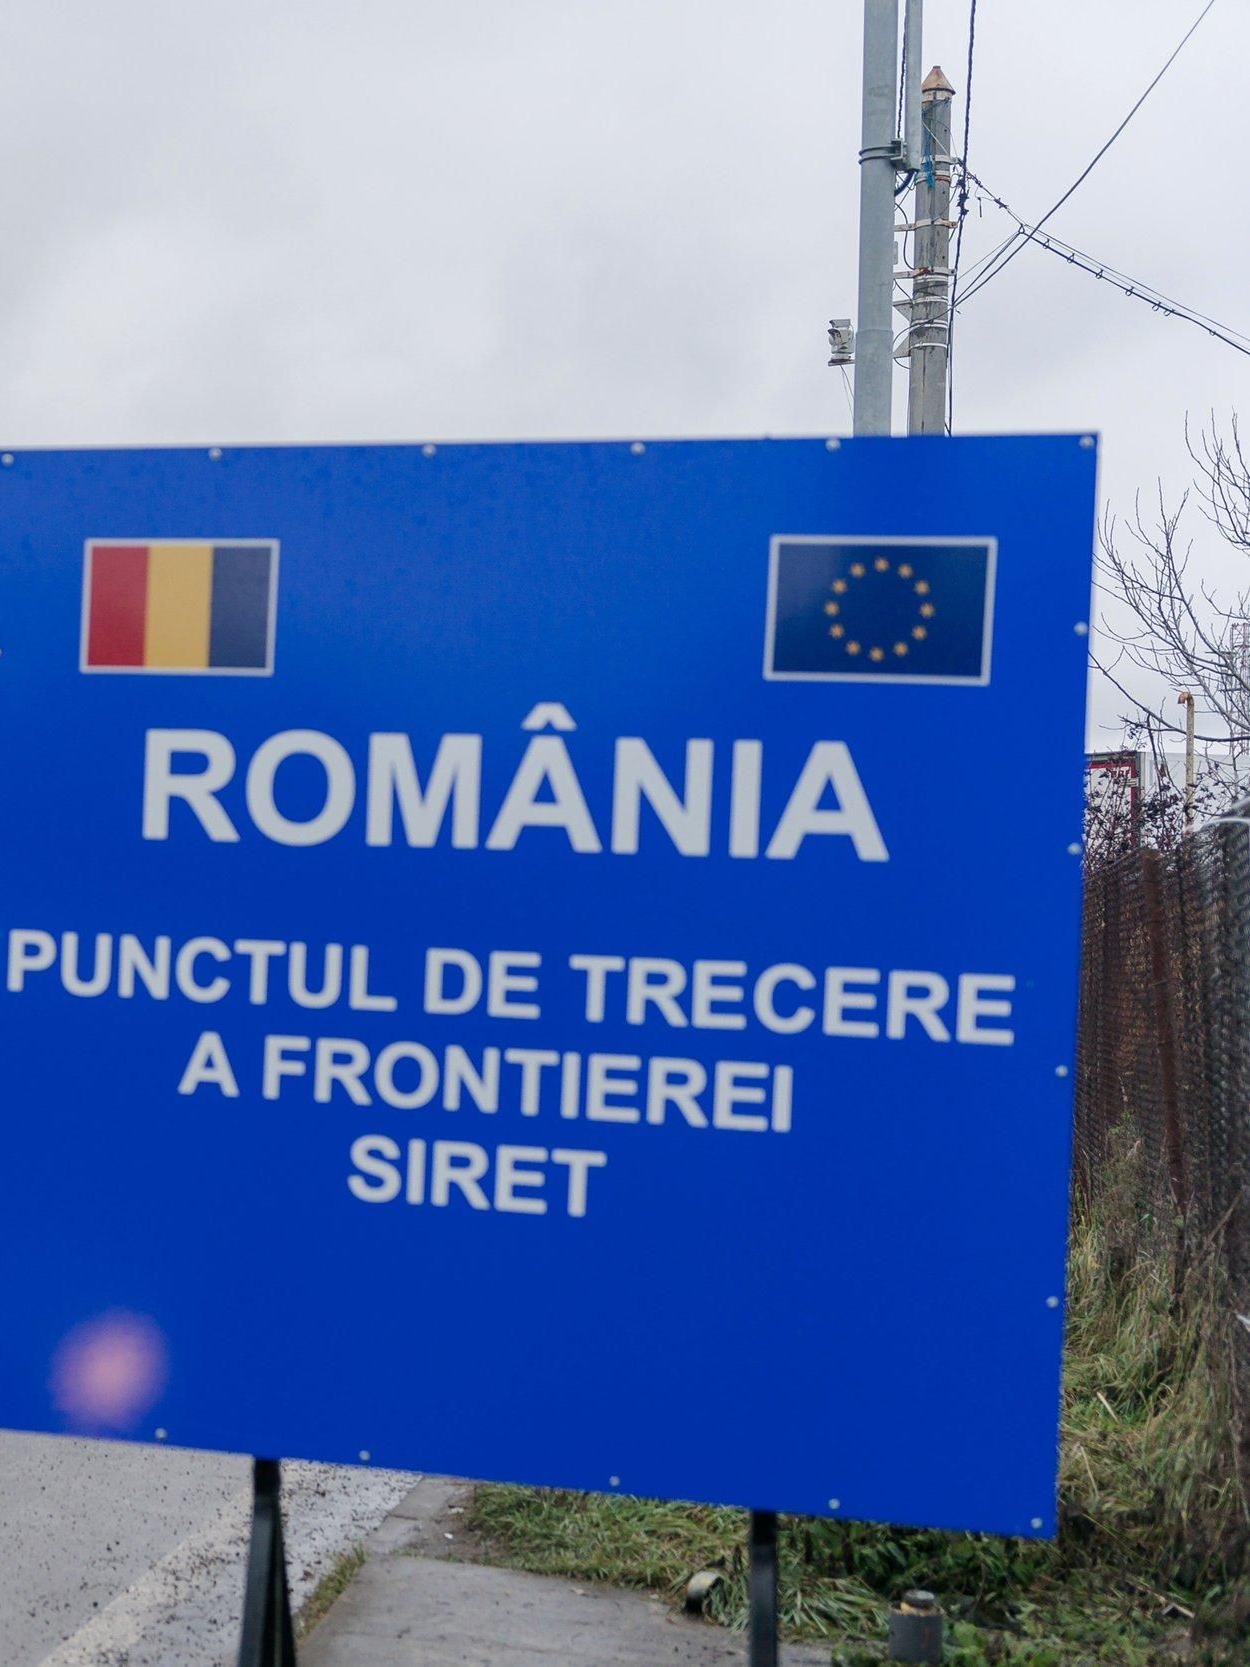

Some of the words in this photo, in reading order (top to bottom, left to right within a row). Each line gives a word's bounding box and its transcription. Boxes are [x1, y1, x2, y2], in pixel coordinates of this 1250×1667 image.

[141, 702, 889, 861] ROMÂNIA
[6, 929, 397, 1011] PUNCTUL
[424, 948, 541, 1019] DE
[569, 955, 1016, 1045] TRECERE
[178, 1032, 239, 1097] A
[263, 1035, 793, 1132] FRONTIEREI
[348, 1135, 607, 1217] SIRET
